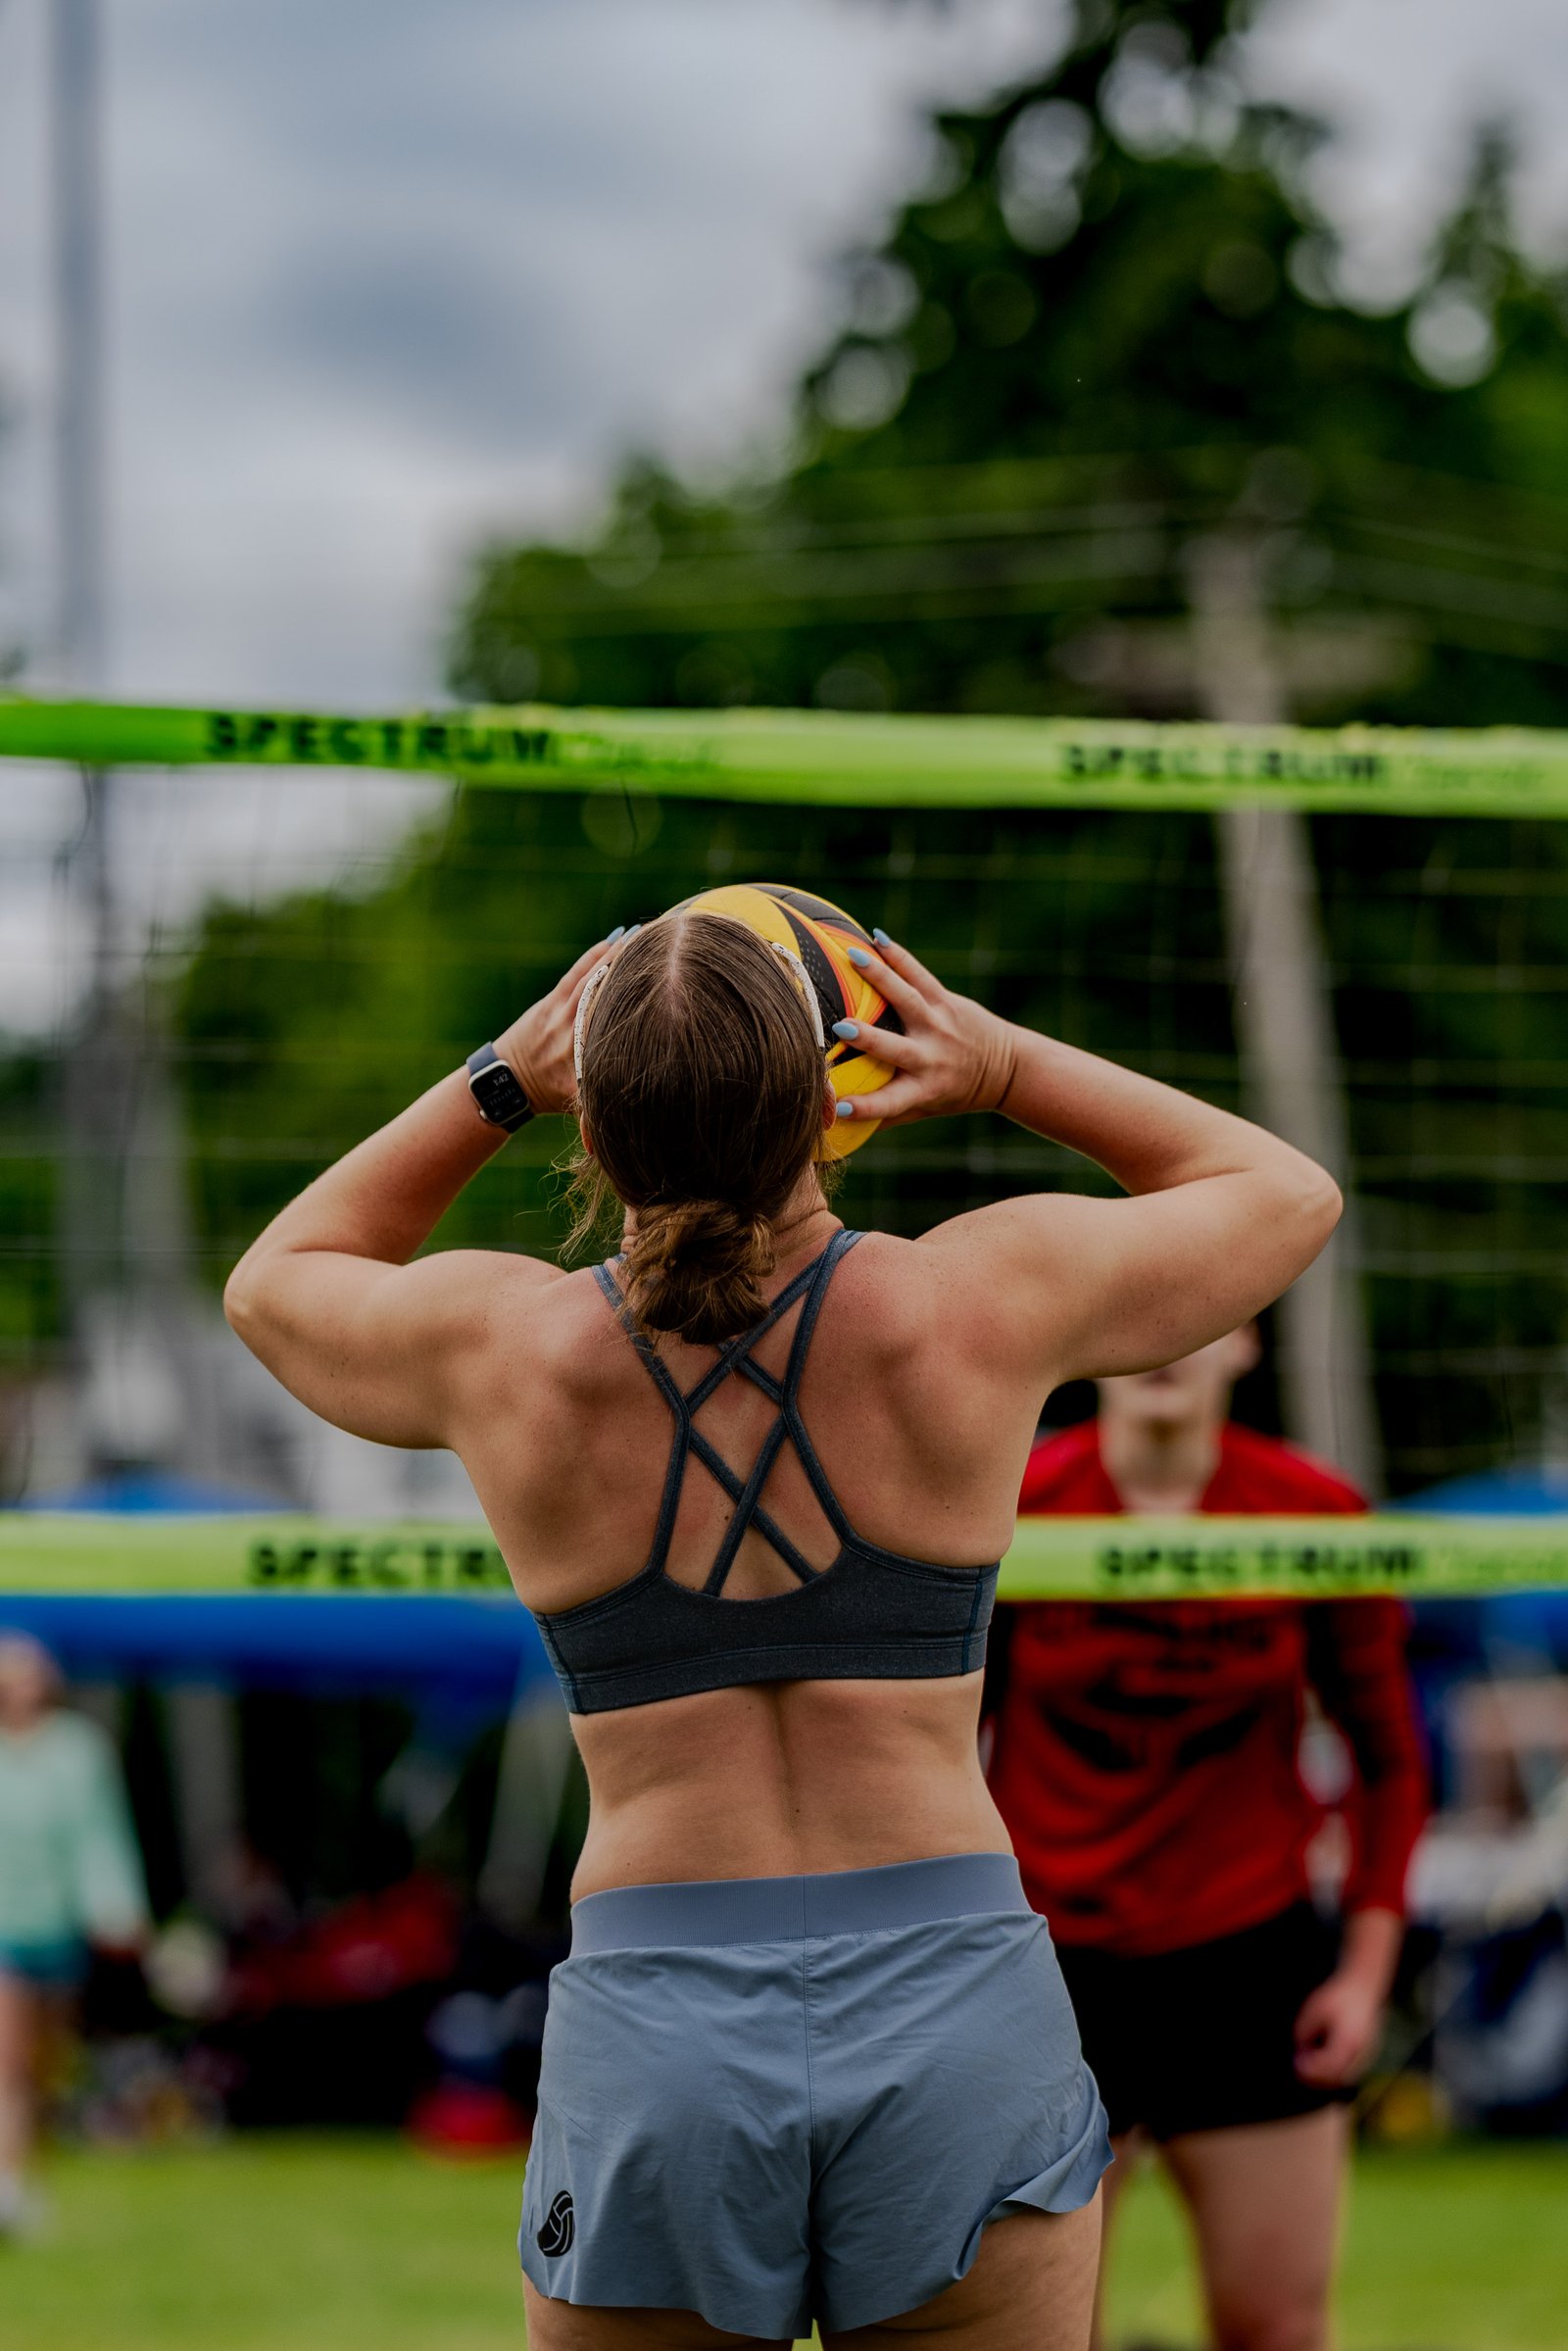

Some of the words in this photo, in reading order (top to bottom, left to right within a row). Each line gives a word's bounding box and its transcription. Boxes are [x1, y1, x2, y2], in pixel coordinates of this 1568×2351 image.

[204, 712, 555, 766] SPECTRUM
[1059, 742, 1389, 786] SPECTRUM
[251, 1542, 515, 1589] SPECTR
[1098, 1542, 1423, 1586] SPECTRUM
